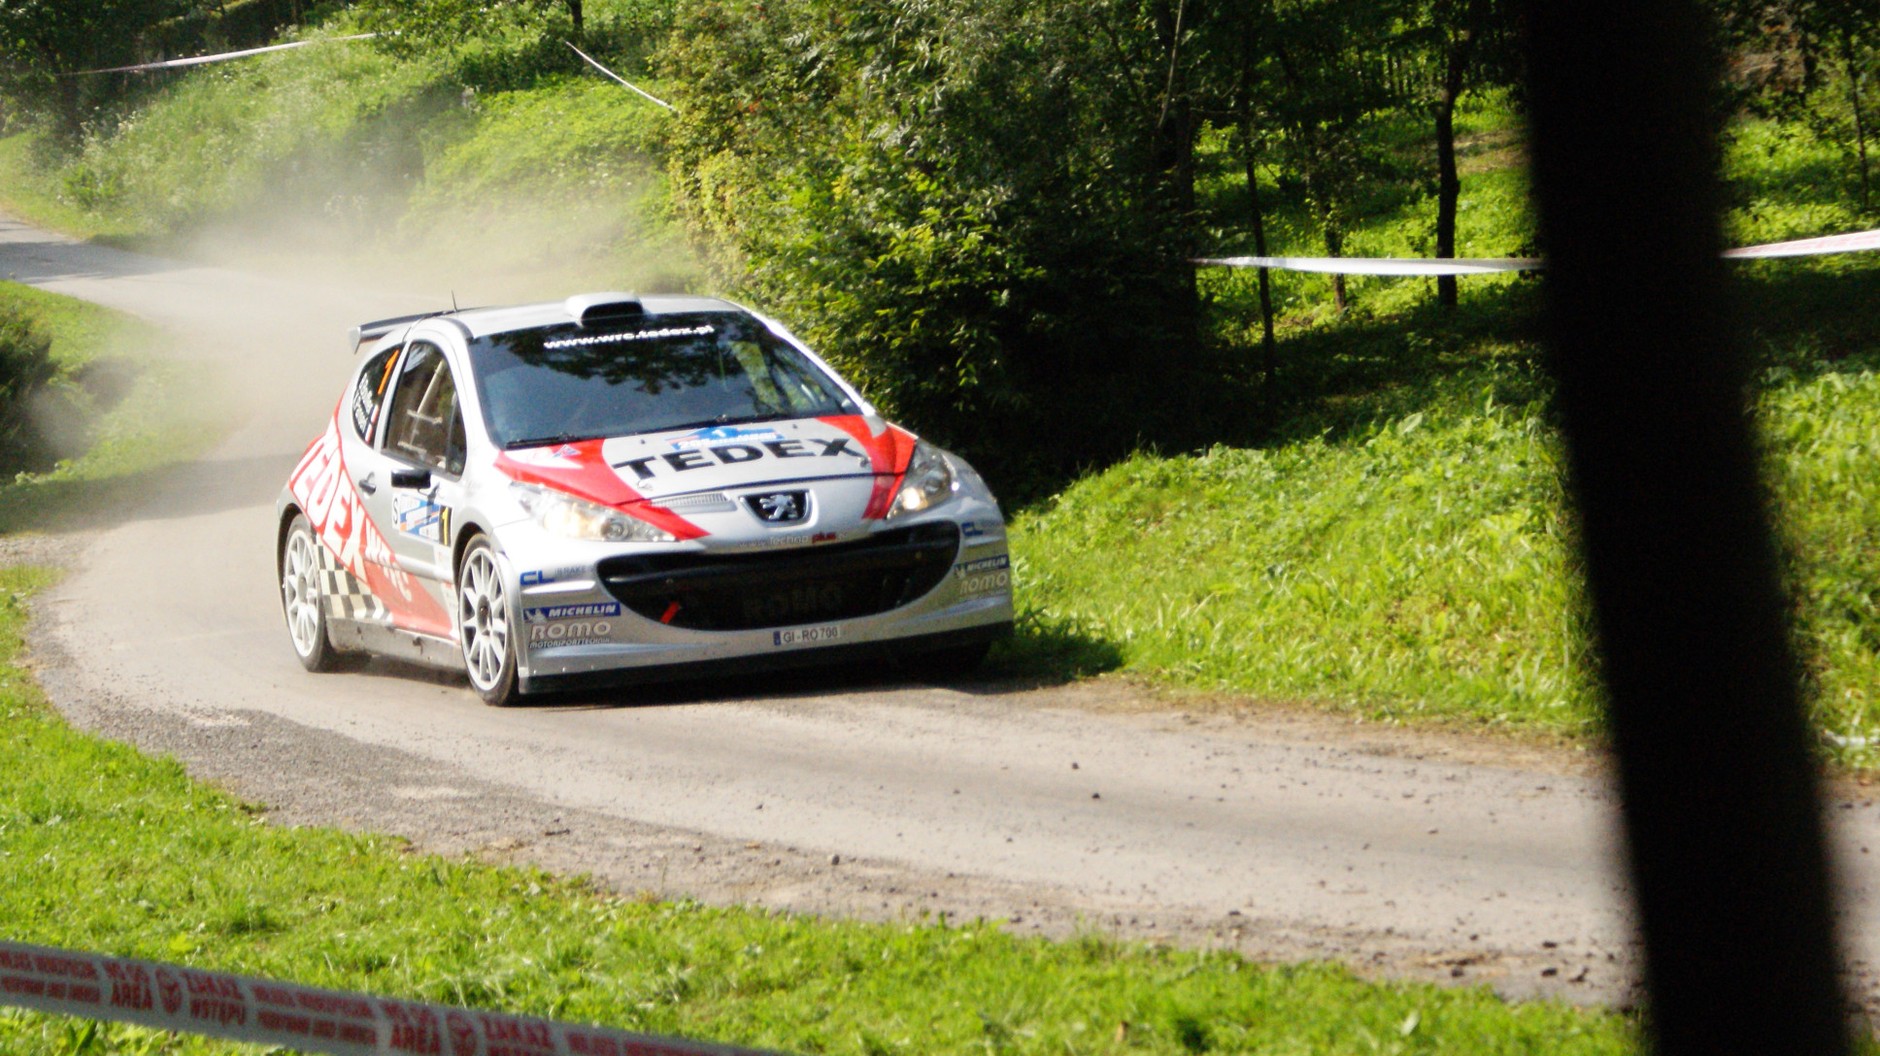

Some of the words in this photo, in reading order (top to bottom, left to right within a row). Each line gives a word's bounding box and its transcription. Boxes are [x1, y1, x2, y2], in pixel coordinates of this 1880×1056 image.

[543, 325, 715, 349] www.wrc.tedex.pl
[377, 349, 400, 395] 1
[613, 438, 867, 480] TEDEX
[290, 415, 370, 584] TEDEX
[441, 507, 449, 546] 1
[967, 557, 1007, 571] MICHELIN
[548, 604, 616, 617] MICHELIN
[531, 622, 611, 640] ROMO
